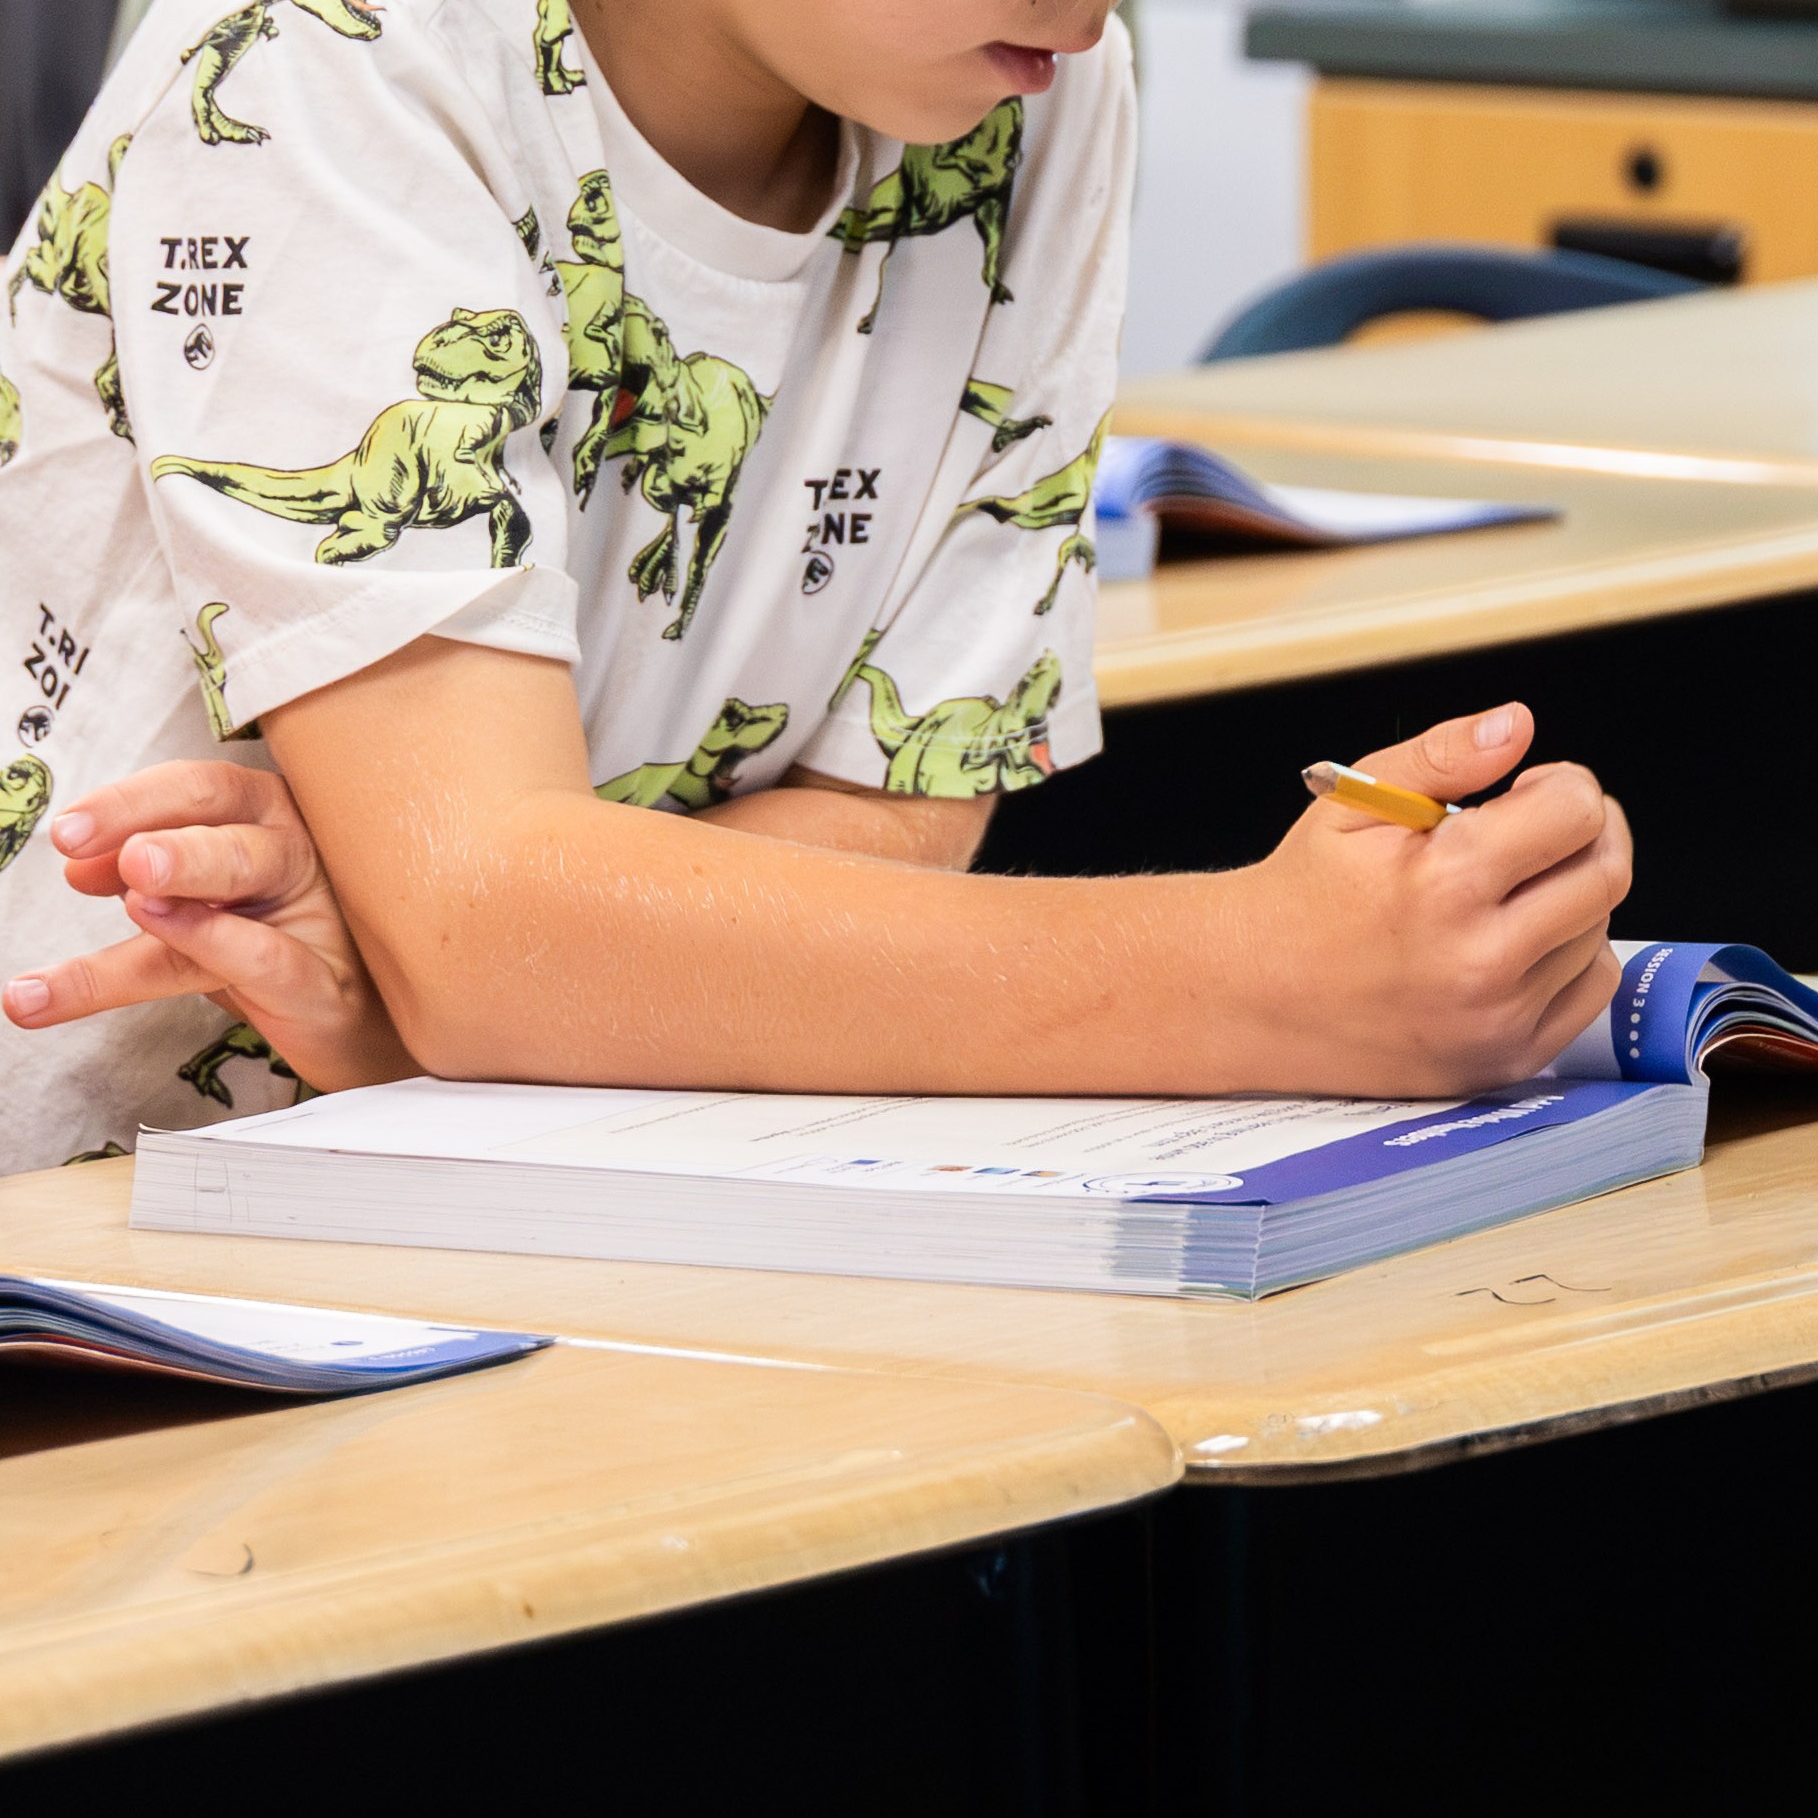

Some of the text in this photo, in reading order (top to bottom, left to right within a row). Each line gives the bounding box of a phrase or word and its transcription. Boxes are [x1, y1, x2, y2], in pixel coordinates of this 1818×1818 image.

[160, 235, 251, 270] T.REX
[151, 281, 245, 317] ZONE
[1633, 948, 1673, 1007] SESSION 3
